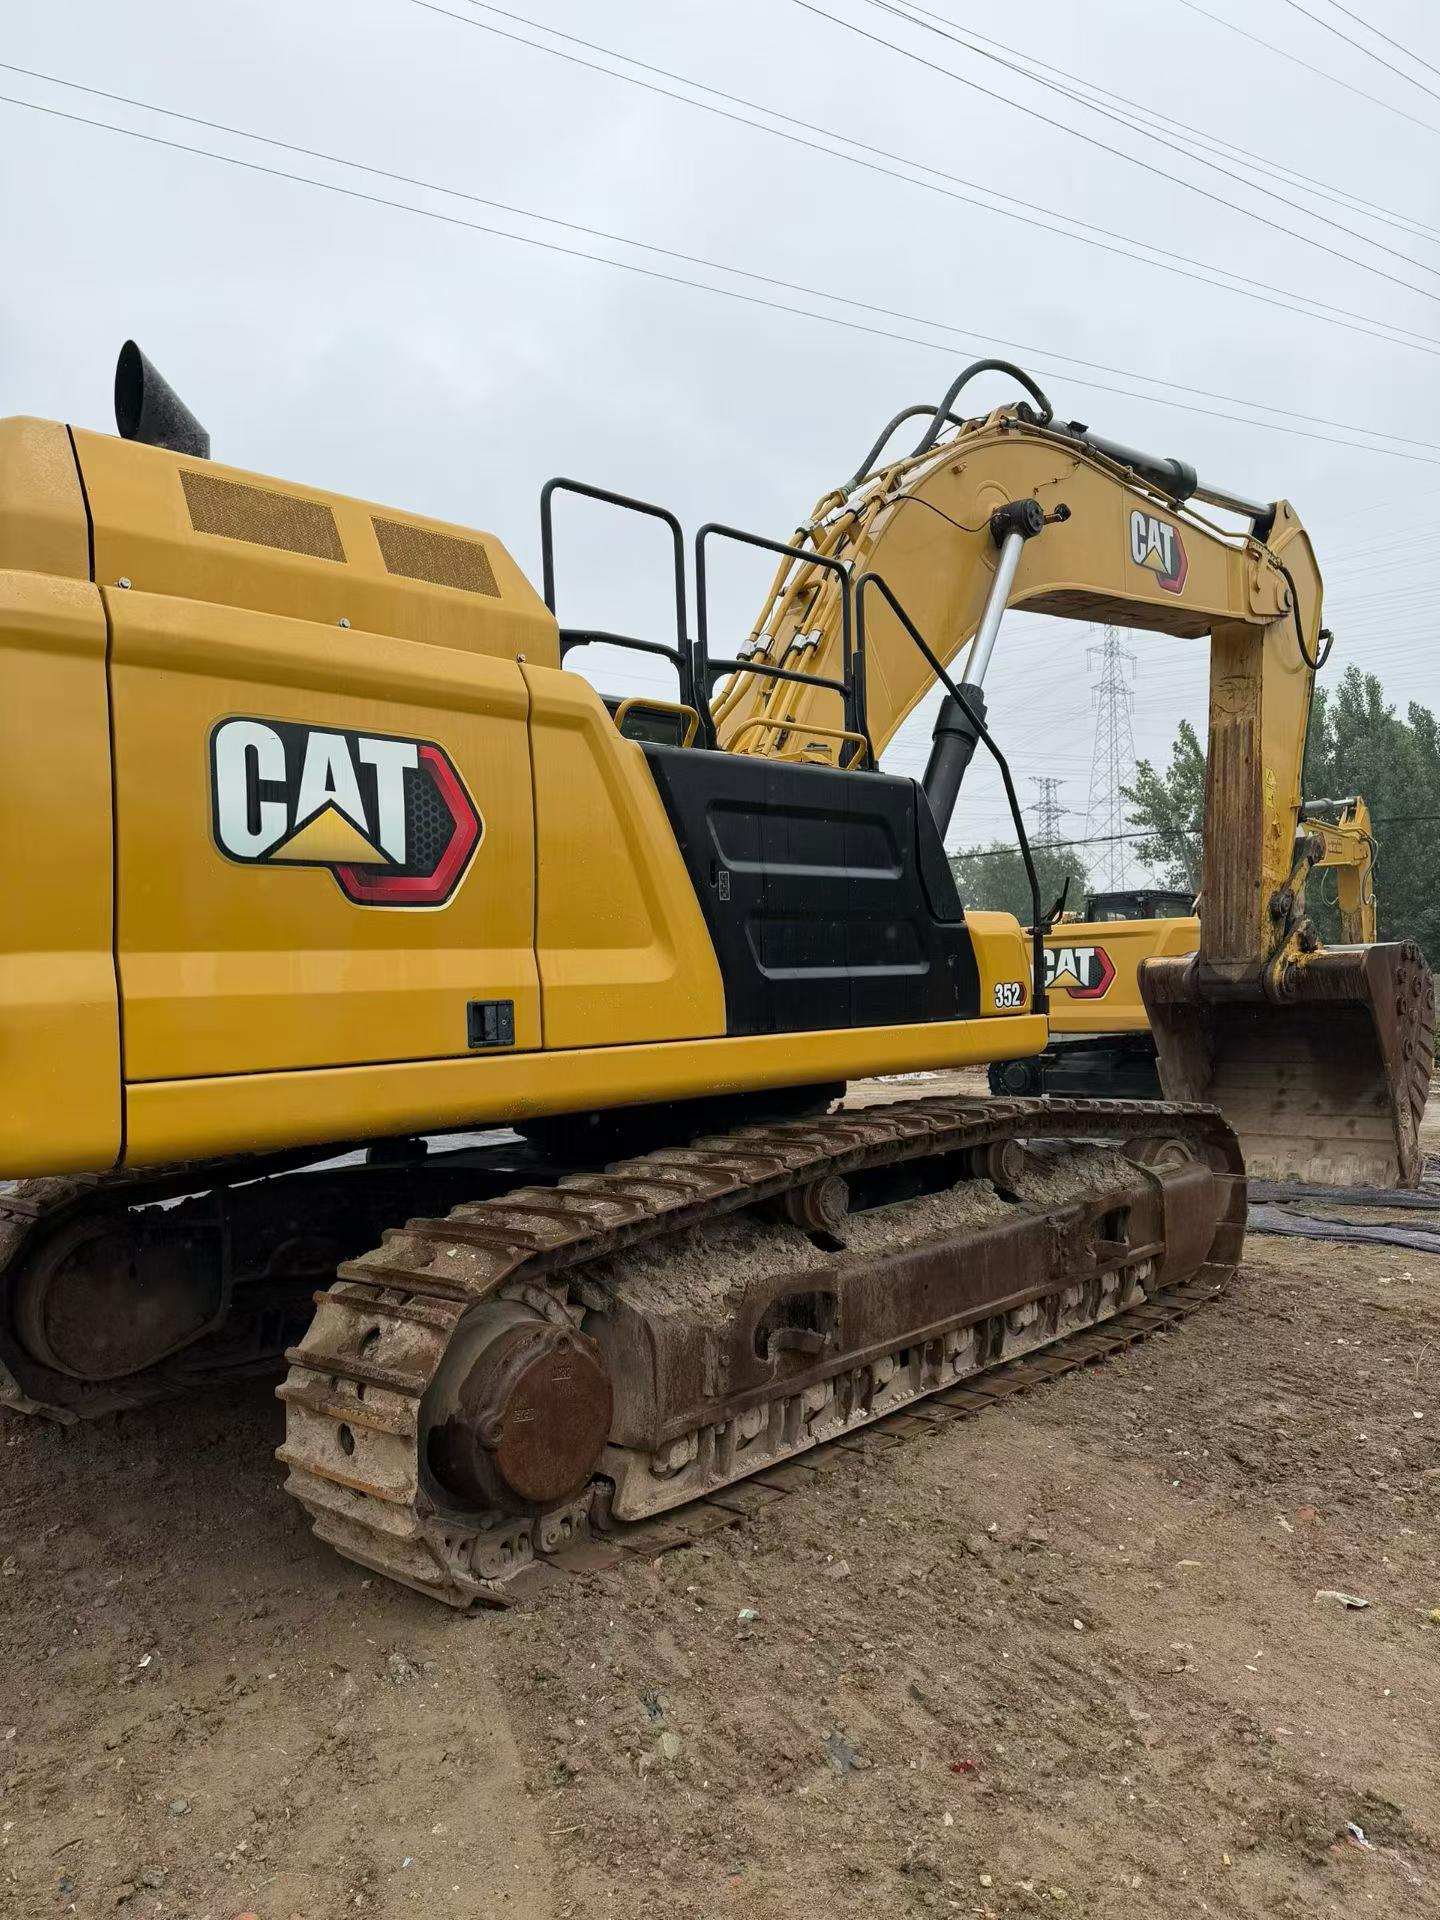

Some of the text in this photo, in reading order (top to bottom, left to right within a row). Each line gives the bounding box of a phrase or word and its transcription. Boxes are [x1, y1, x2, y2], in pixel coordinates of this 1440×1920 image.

[1131, 511, 1173, 575] CAT
[216, 721, 418, 864] CAT
[995, 983, 1020, 1006] 352
